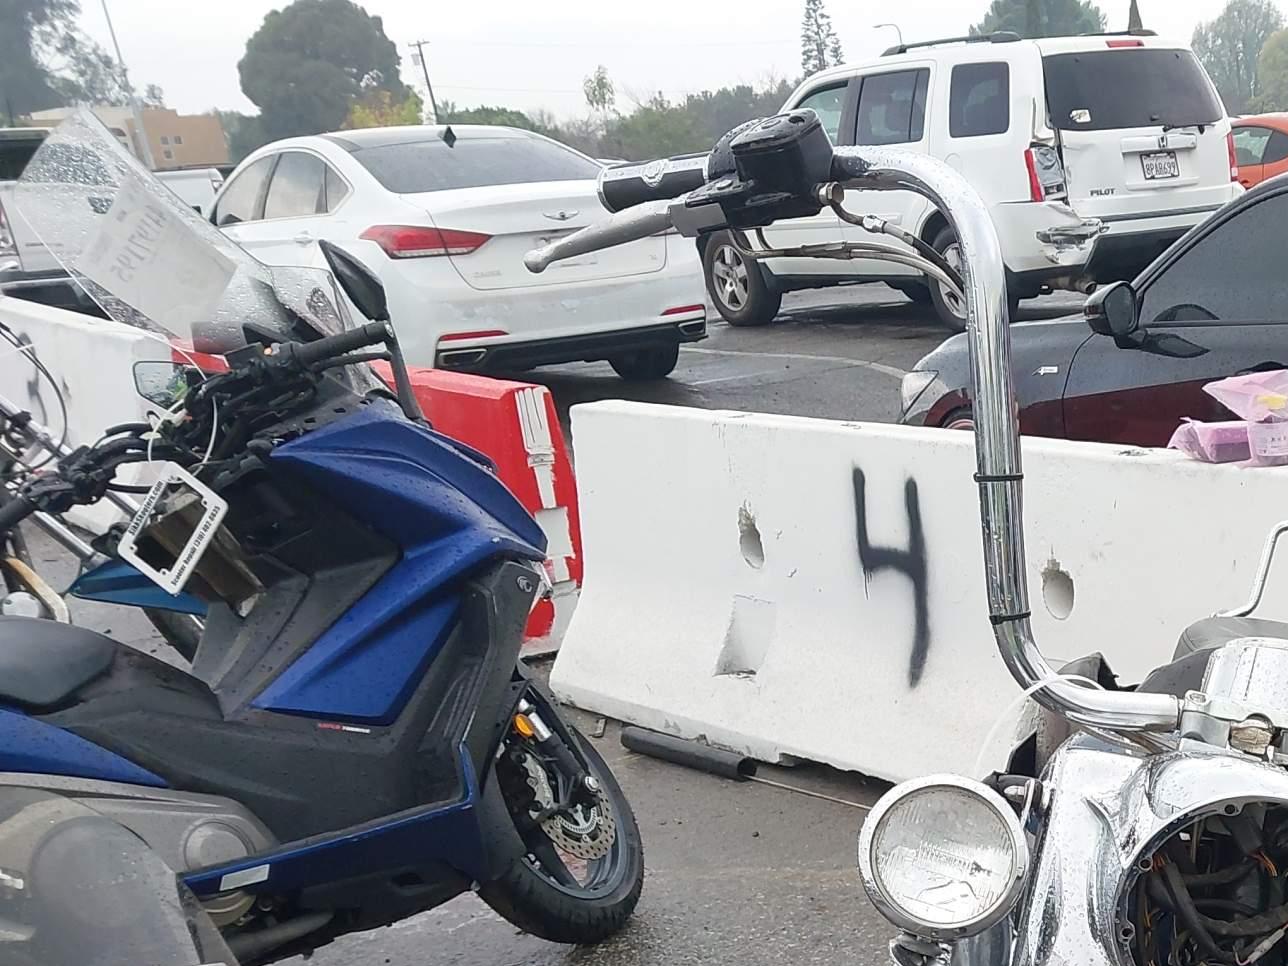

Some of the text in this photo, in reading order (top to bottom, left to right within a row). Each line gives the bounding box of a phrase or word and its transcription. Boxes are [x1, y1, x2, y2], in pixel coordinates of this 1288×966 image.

[1089, 188, 1116, 197] PILOT
[170, 564, 187, 586] Scooter
[184, 546, 198, 567] Repair
[852, 466, 931, 689] 4
